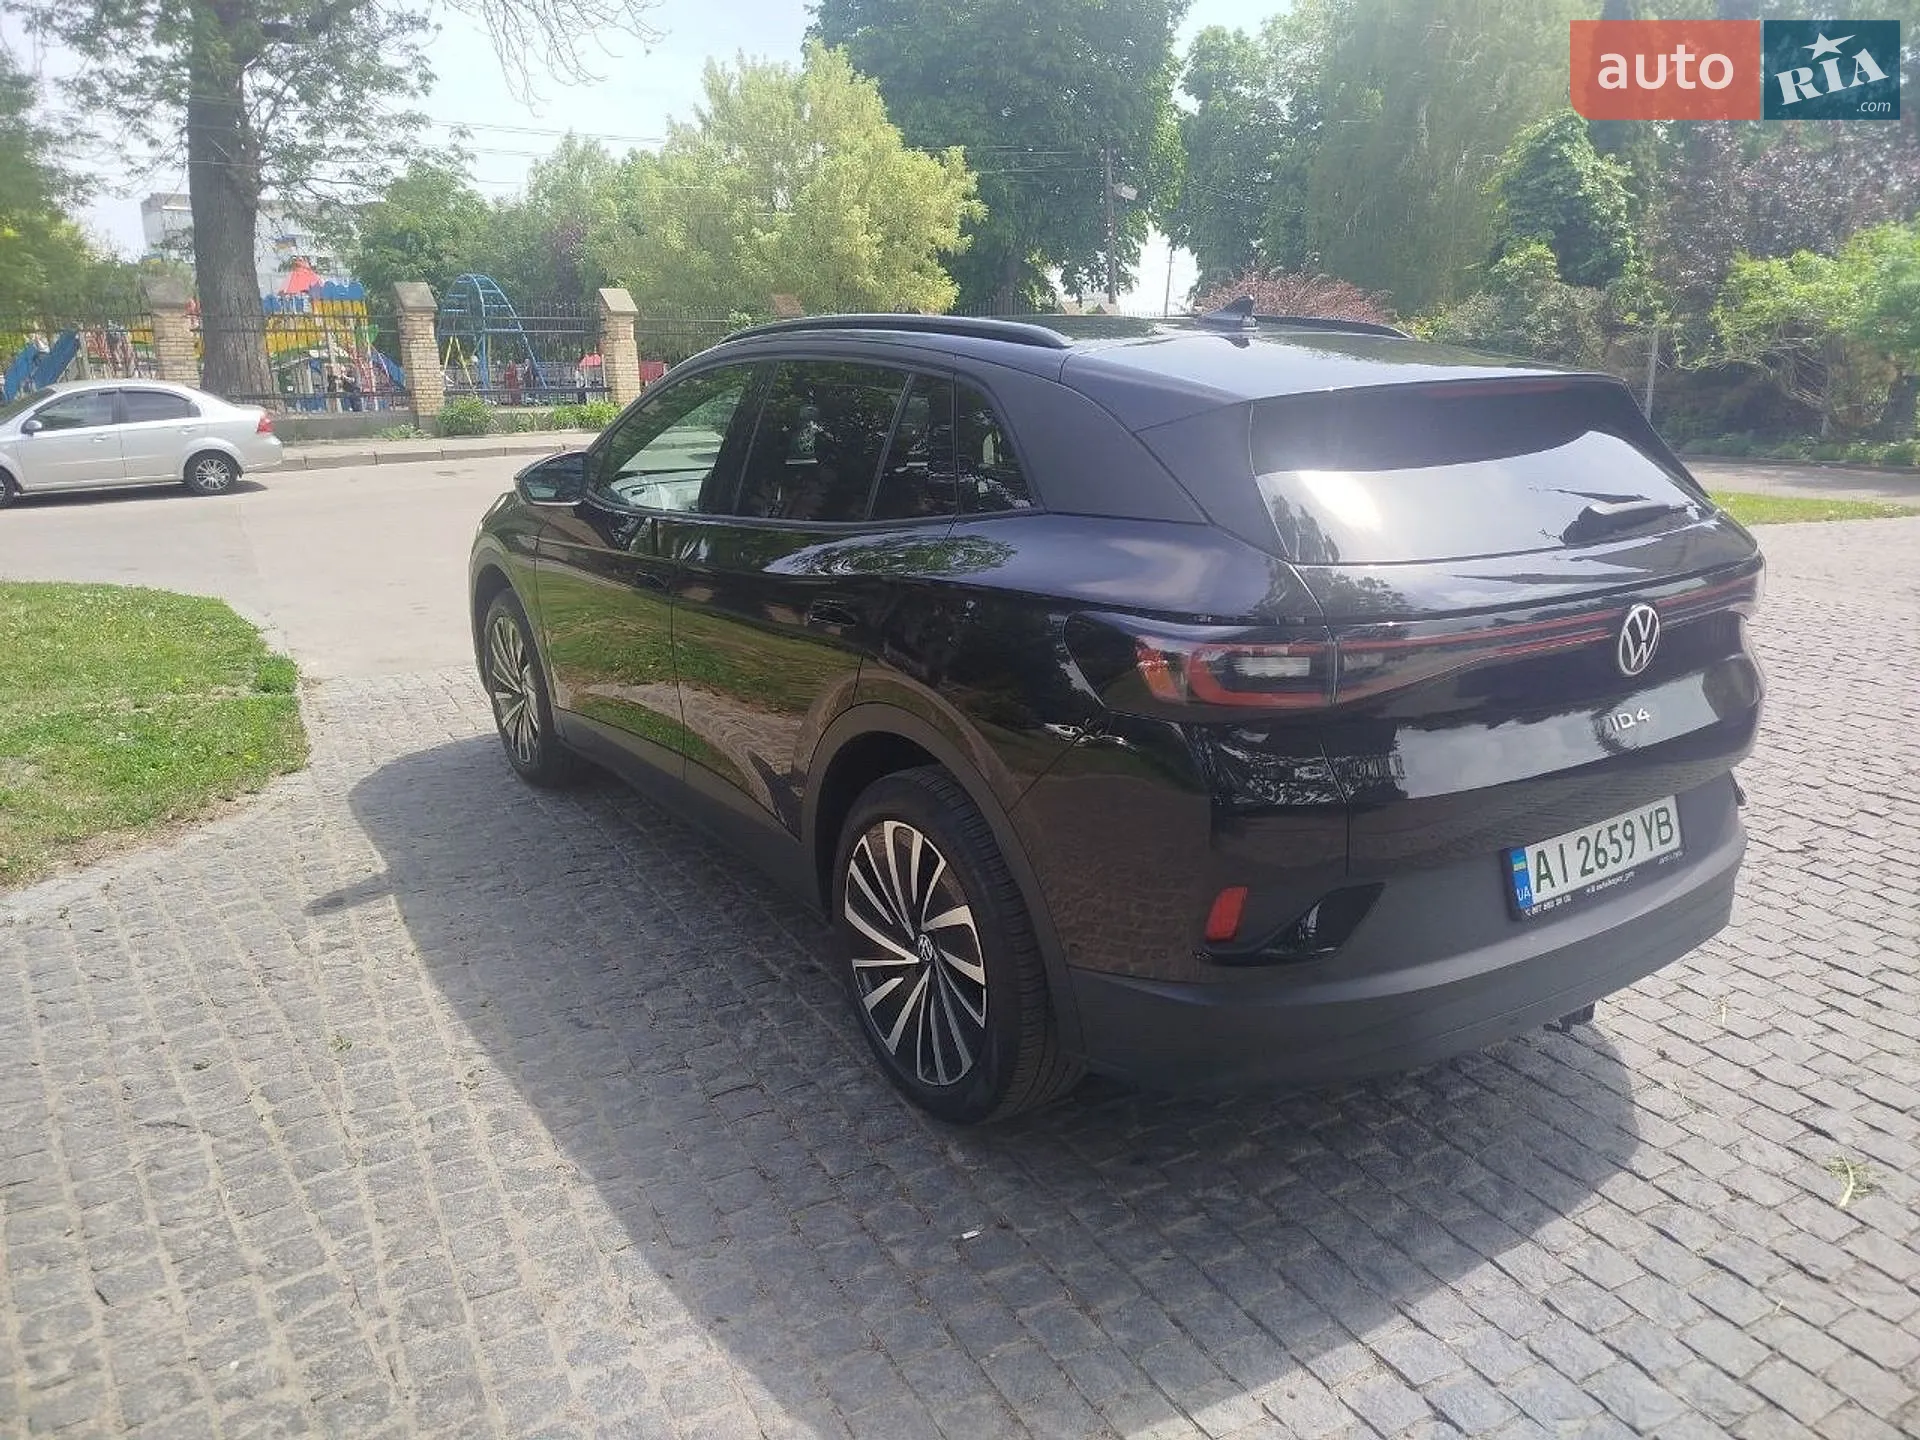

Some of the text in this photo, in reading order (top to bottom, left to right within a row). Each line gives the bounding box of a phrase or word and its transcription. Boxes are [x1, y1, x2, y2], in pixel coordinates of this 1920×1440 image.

[1536, 843, 1569, 893] AI
[1577, 818, 1635, 877] 2659
[1640, 806, 1674, 851] YB
[1516, 885, 1533, 902] UA
